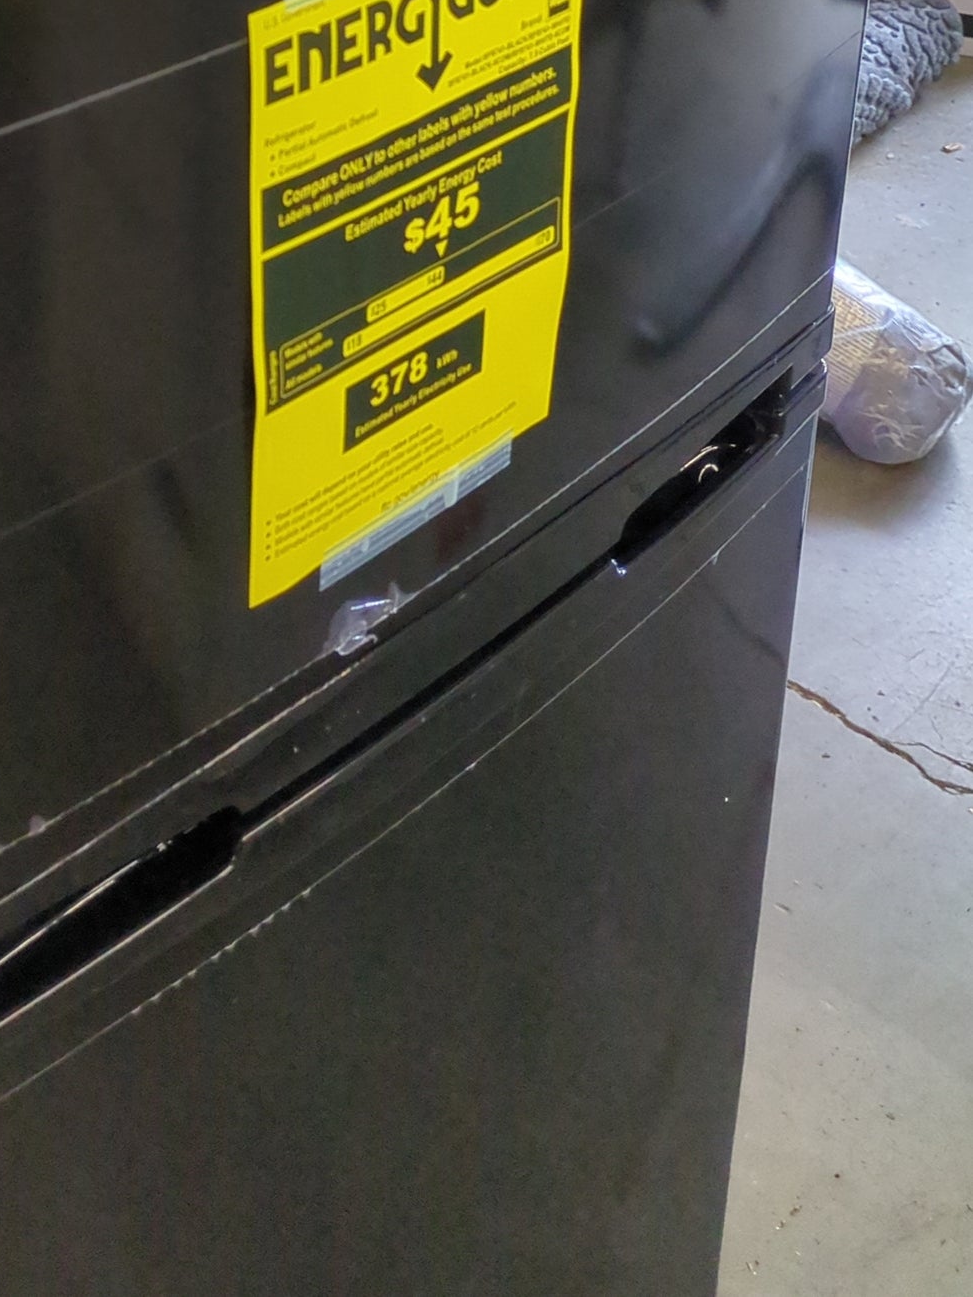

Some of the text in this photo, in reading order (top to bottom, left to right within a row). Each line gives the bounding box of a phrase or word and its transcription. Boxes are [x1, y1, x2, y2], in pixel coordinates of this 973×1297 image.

[278, 204, 312, 228] Labels
[312, 193, 334, 212] with
[334, 179, 365, 205] yellow
[365, 160, 404, 187] numbers
[405, 153, 419, 168] are
[419, 137, 445, 160] based
[445, 133, 457, 148] on
[457, 125, 472, 141] the
[472, 115, 495, 134] same
[495, 105, 511, 122] test
[283, 172, 339, 207] Compare
[340, 152, 373, 181] ONLY
[374, 149, 386, 165] to
[387, 134, 417, 158] other
[418, 116, 450, 142] labels
[450, 103, 474, 126] with
[474, 89, 509, 119] yellow
[509, 67, 557, 98] numbers.
[345, 150, 503, 242] Estimated Yearly Energy Cost
[403, 181, 480, 254] $45
[355, 362, 473, 439] Estimated Yearly Electricity Use
[370, 349, 458, 407] 378 kWh
